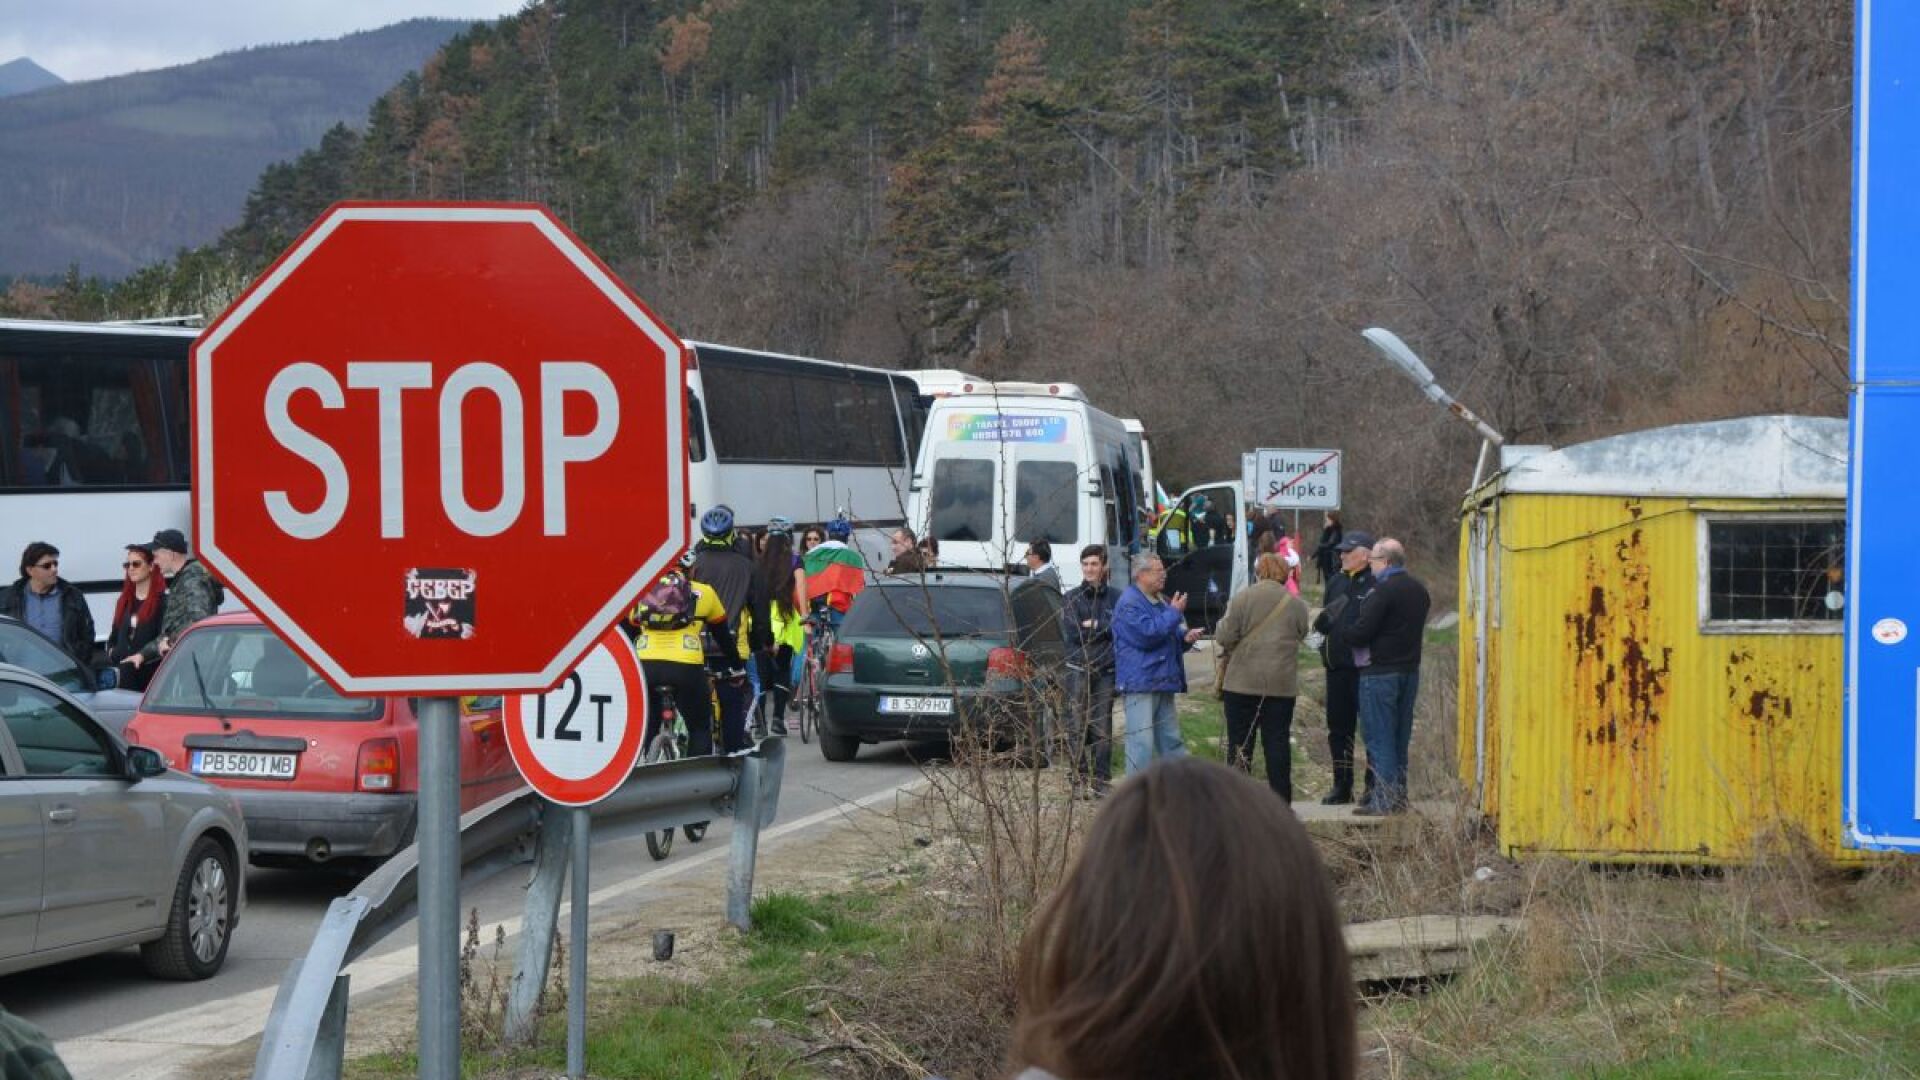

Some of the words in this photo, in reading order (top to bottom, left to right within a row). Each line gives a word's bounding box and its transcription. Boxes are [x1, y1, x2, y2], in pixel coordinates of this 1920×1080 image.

[263, 361, 620, 540] STOP
[1269, 459, 1327, 474] Шипка
[1269, 481, 1327, 499] Shipka
